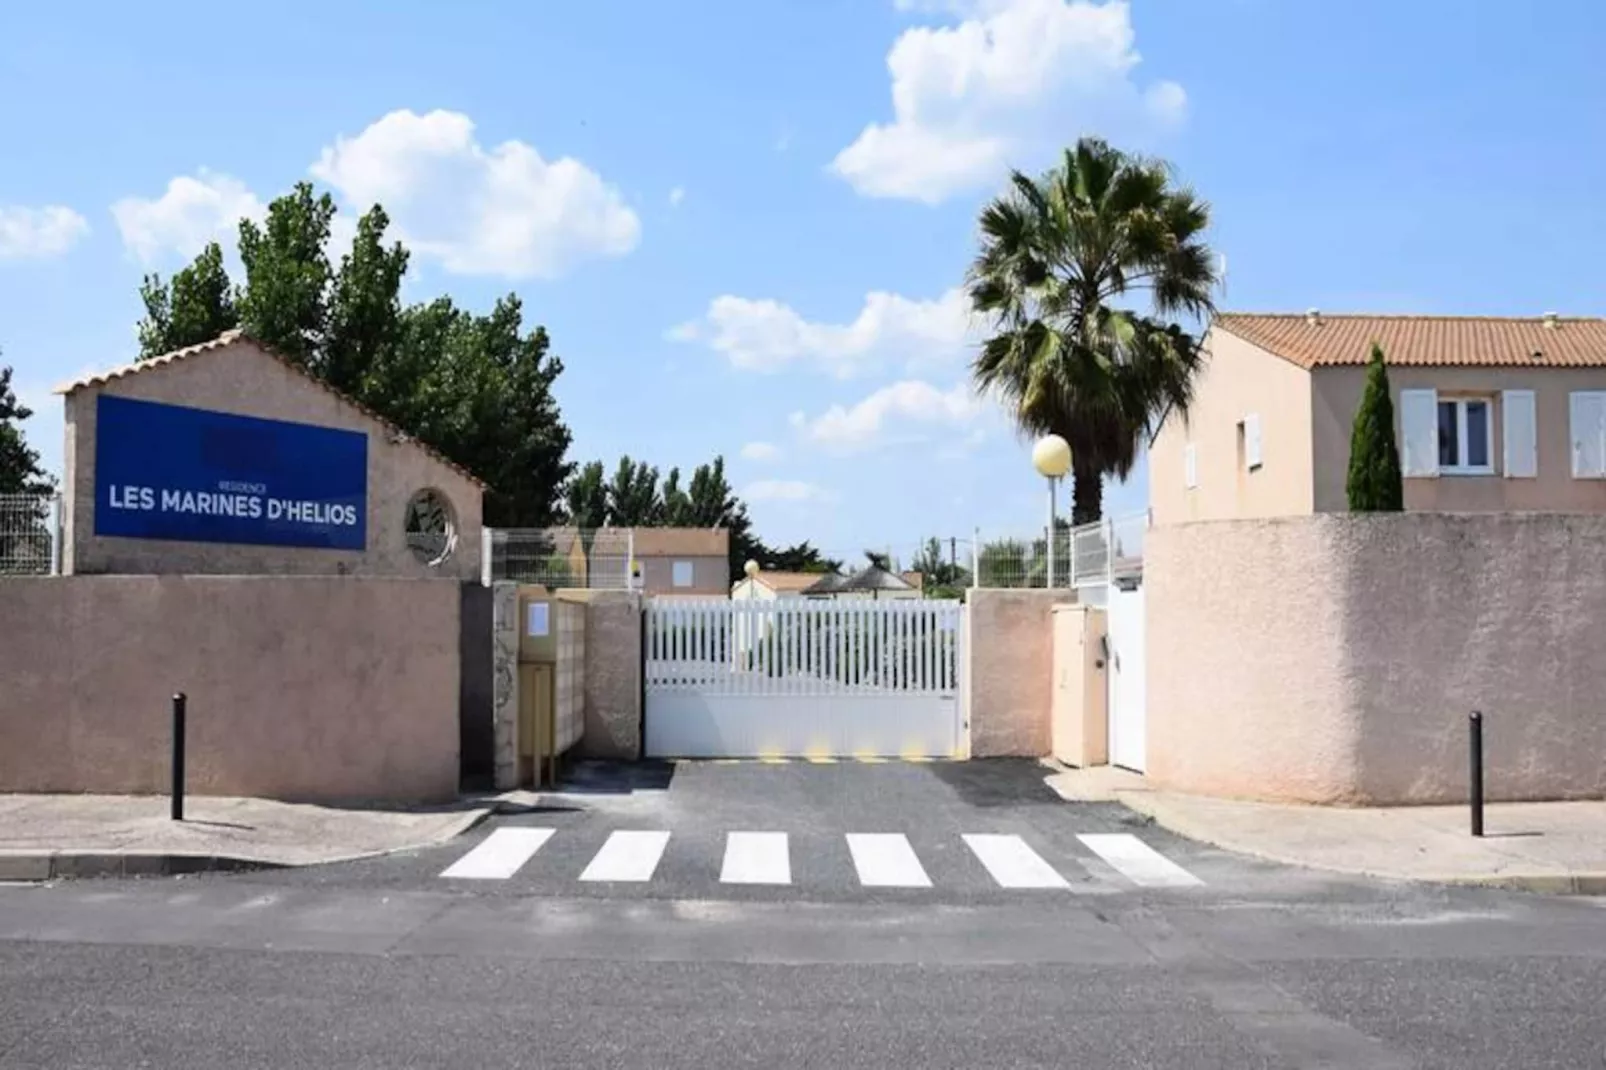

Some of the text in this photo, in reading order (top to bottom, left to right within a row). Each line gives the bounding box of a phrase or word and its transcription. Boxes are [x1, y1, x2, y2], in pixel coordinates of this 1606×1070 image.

[109, 484, 357, 525] LES MARINES D'HELIOS
